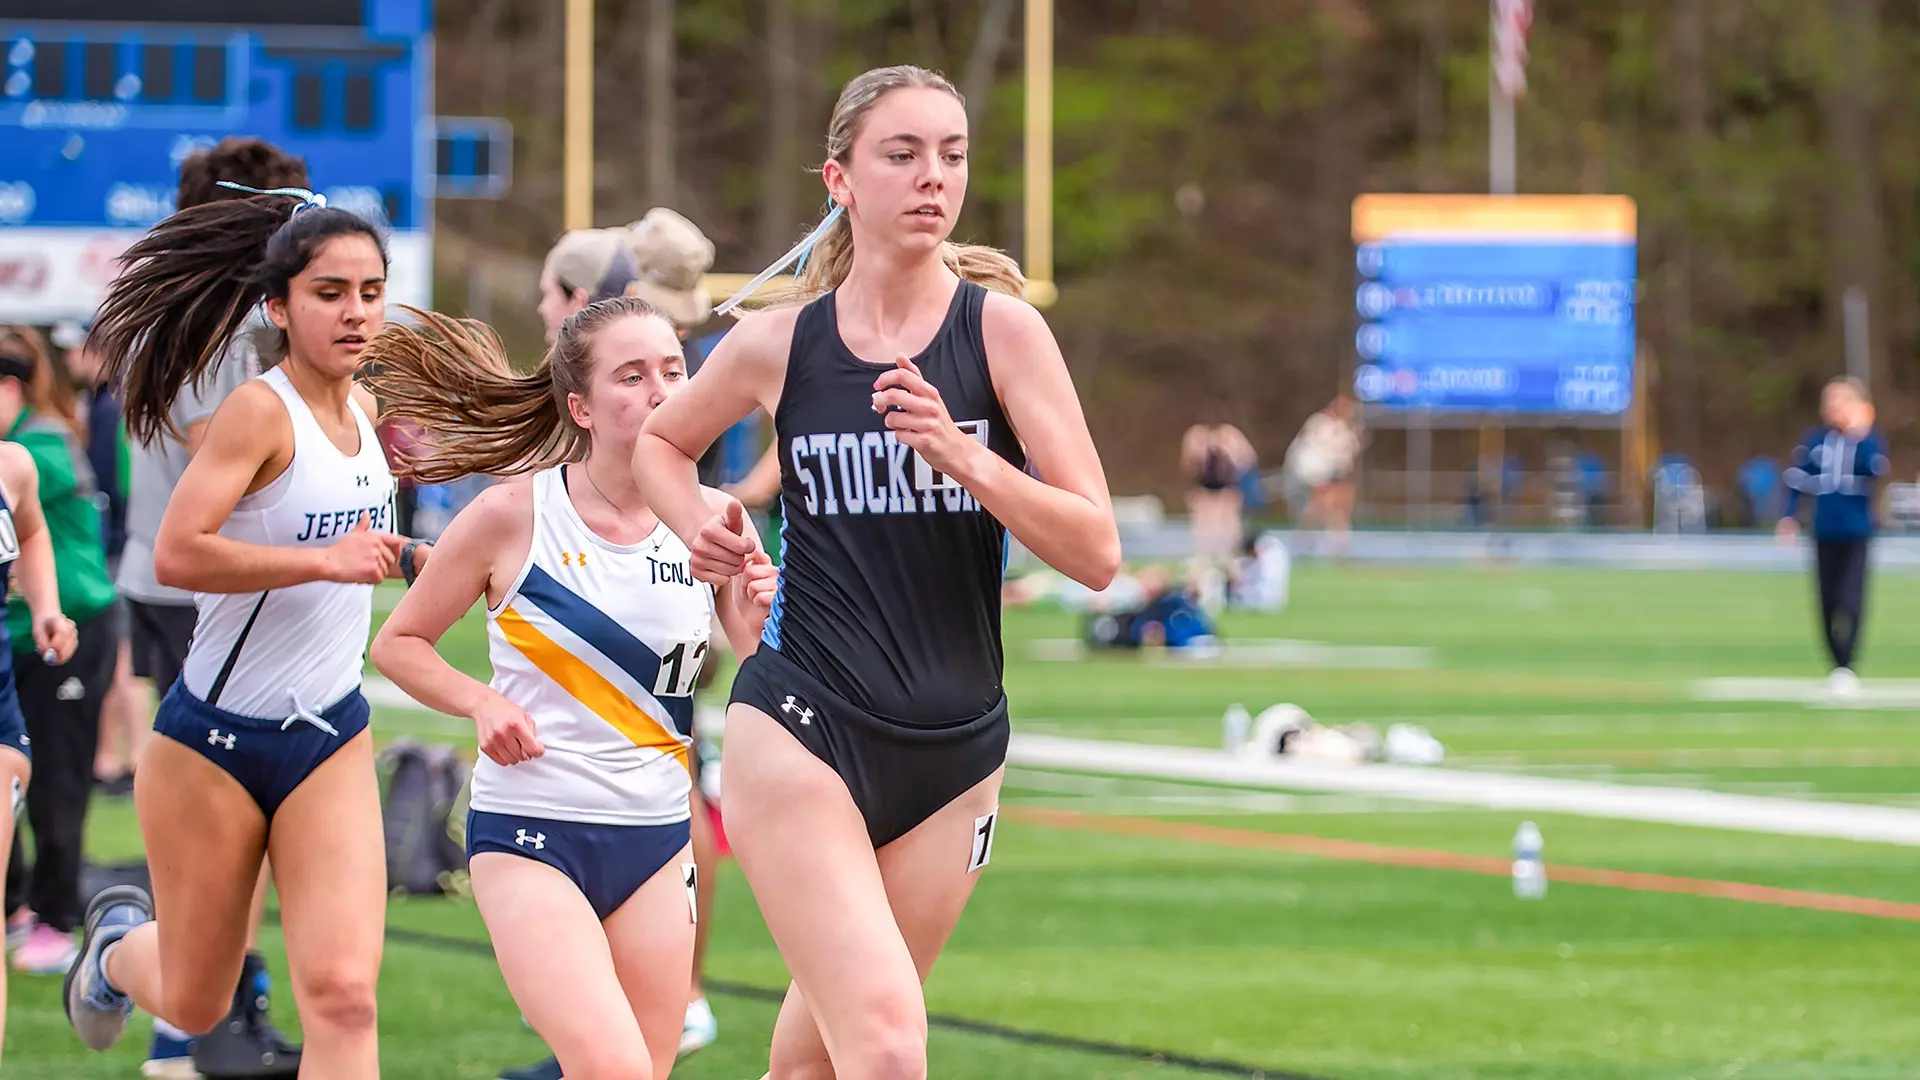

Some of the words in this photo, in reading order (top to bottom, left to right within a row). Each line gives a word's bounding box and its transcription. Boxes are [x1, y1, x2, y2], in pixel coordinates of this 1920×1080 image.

[792, 431, 981, 515] STOCK
[646, 556, 694, 587] TCNJ
[976, 814, 993, 866] 1
